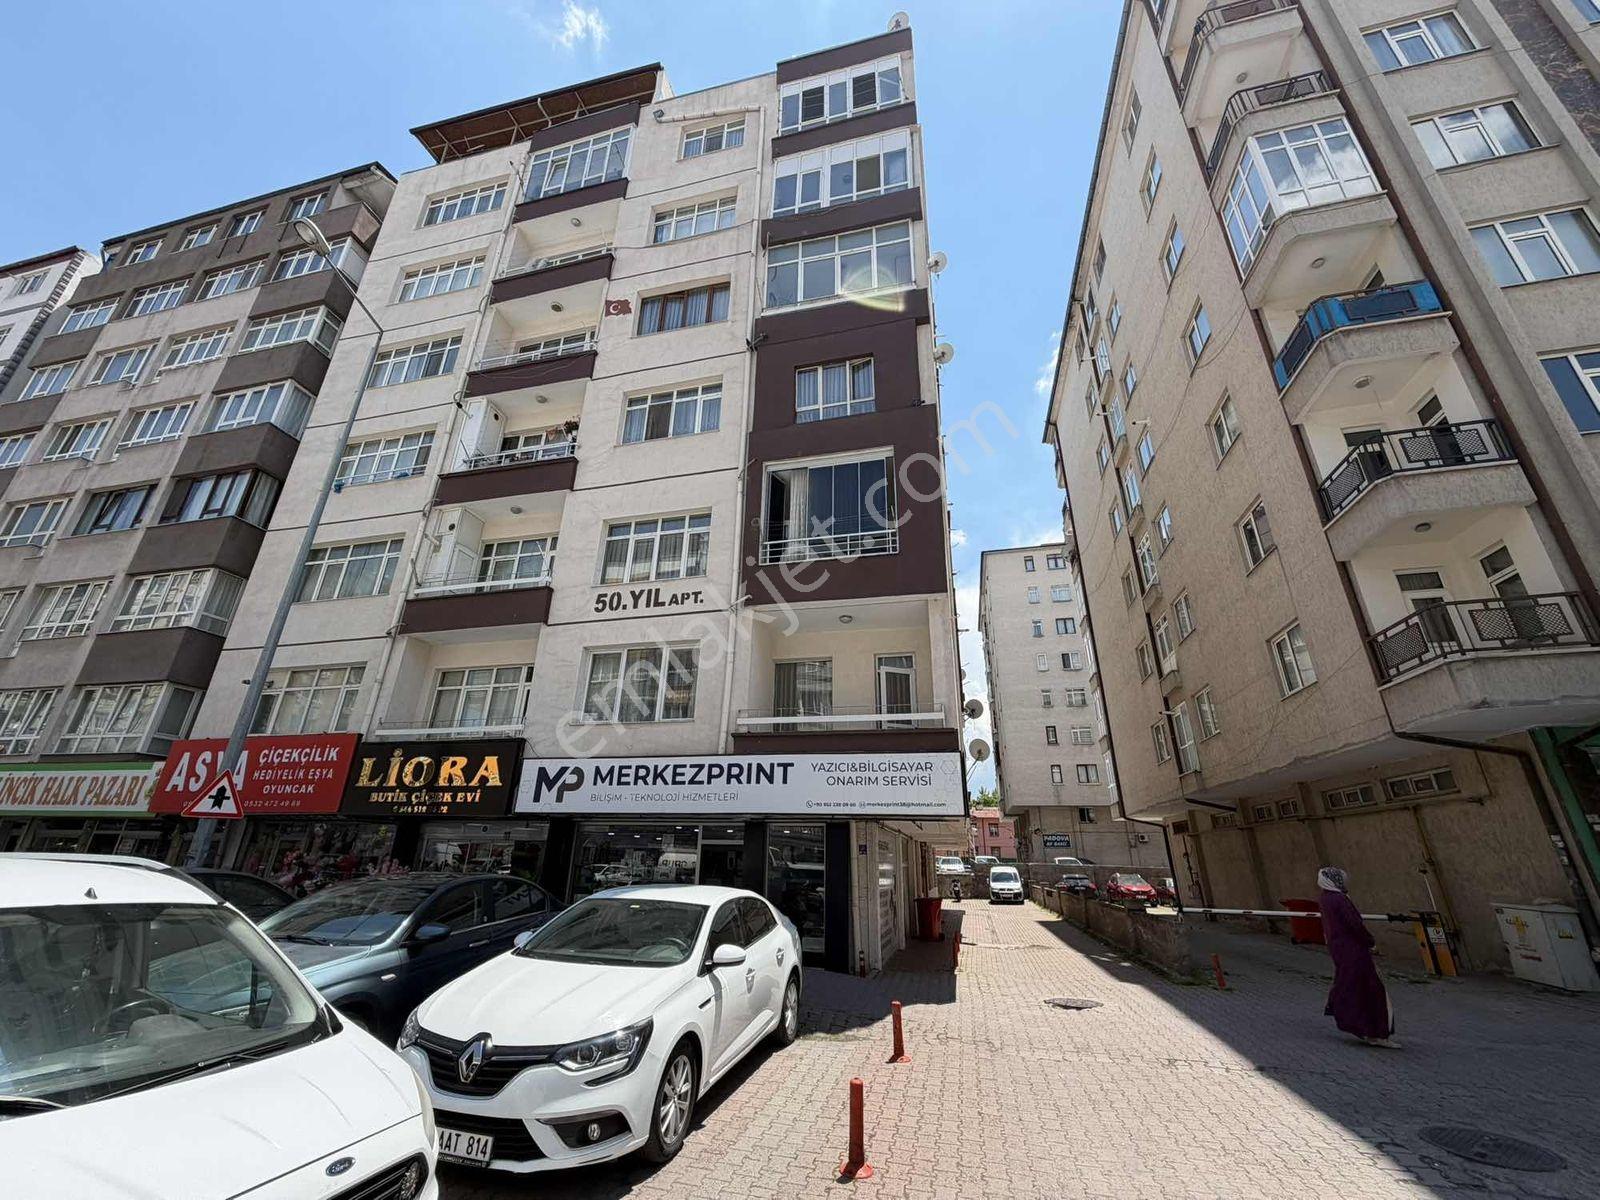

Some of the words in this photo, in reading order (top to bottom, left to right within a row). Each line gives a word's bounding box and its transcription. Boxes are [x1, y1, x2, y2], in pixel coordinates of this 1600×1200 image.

[594, 588, 666, 613] 50.YIL
[667, 591, 704, 606] APT.
[259, 745, 340, 766] ÇİÇEKÇİLİK
[811, 760, 933, 772] YAZICI&BİLGİSAYAR
[252, 768, 304, 781] HEDİYELİK
[307, 768, 333, 780] EŞYA
[355, 748, 502, 787] LİORA
[592, 762, 794, 787] MERKEZPRINT
[36, 776, 87, 805] HALK
[80, 776, 147, 805] PAZARI
[263, 784, 315, 794] OYUNCAK
[533, 766, 585, 803] MP
[826, 775, 879, 786] ONARIM
[882, 774, 932, 787] SERVİSİ
[369, 789, 407, 802] BUTİK
[456, 789, 481, 802] EVİ
[630, 792, 681, 802] TEKNOLOJİ
[466, 1136, 489, 1158] 814
